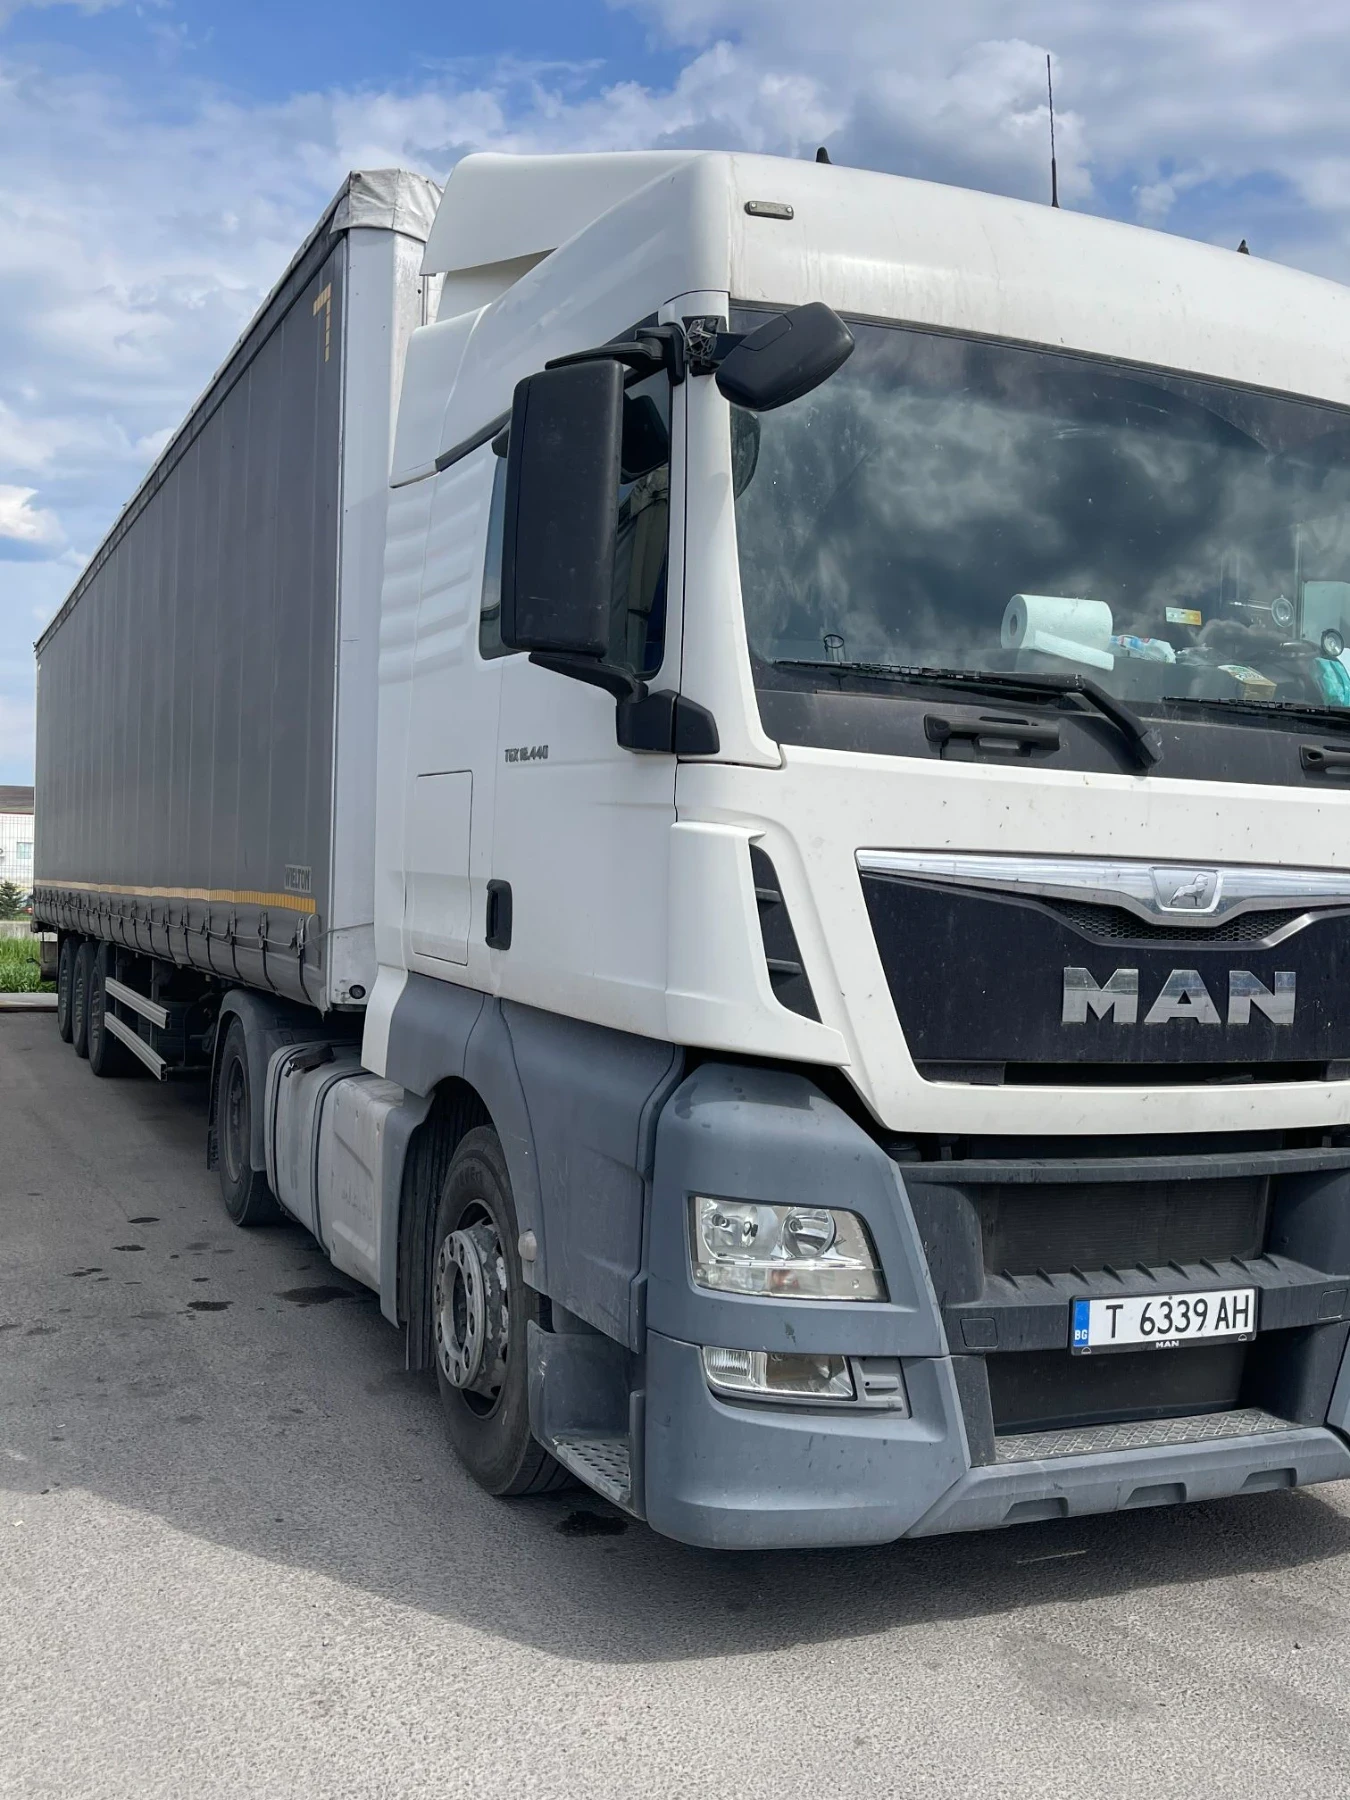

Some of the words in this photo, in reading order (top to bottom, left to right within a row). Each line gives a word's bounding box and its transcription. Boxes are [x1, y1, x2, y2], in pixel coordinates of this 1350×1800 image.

[1062, 966, 1296, 1024] MAN
[1106, 1304, 1124, 1339] T
[1139, 1298, 1208, 1337] 6339
[1215, 1294, 1250, 1331] AH
[1074, 1329, 1088, 1341] BG
[1155, 1340, 1180, 1349] MAN
